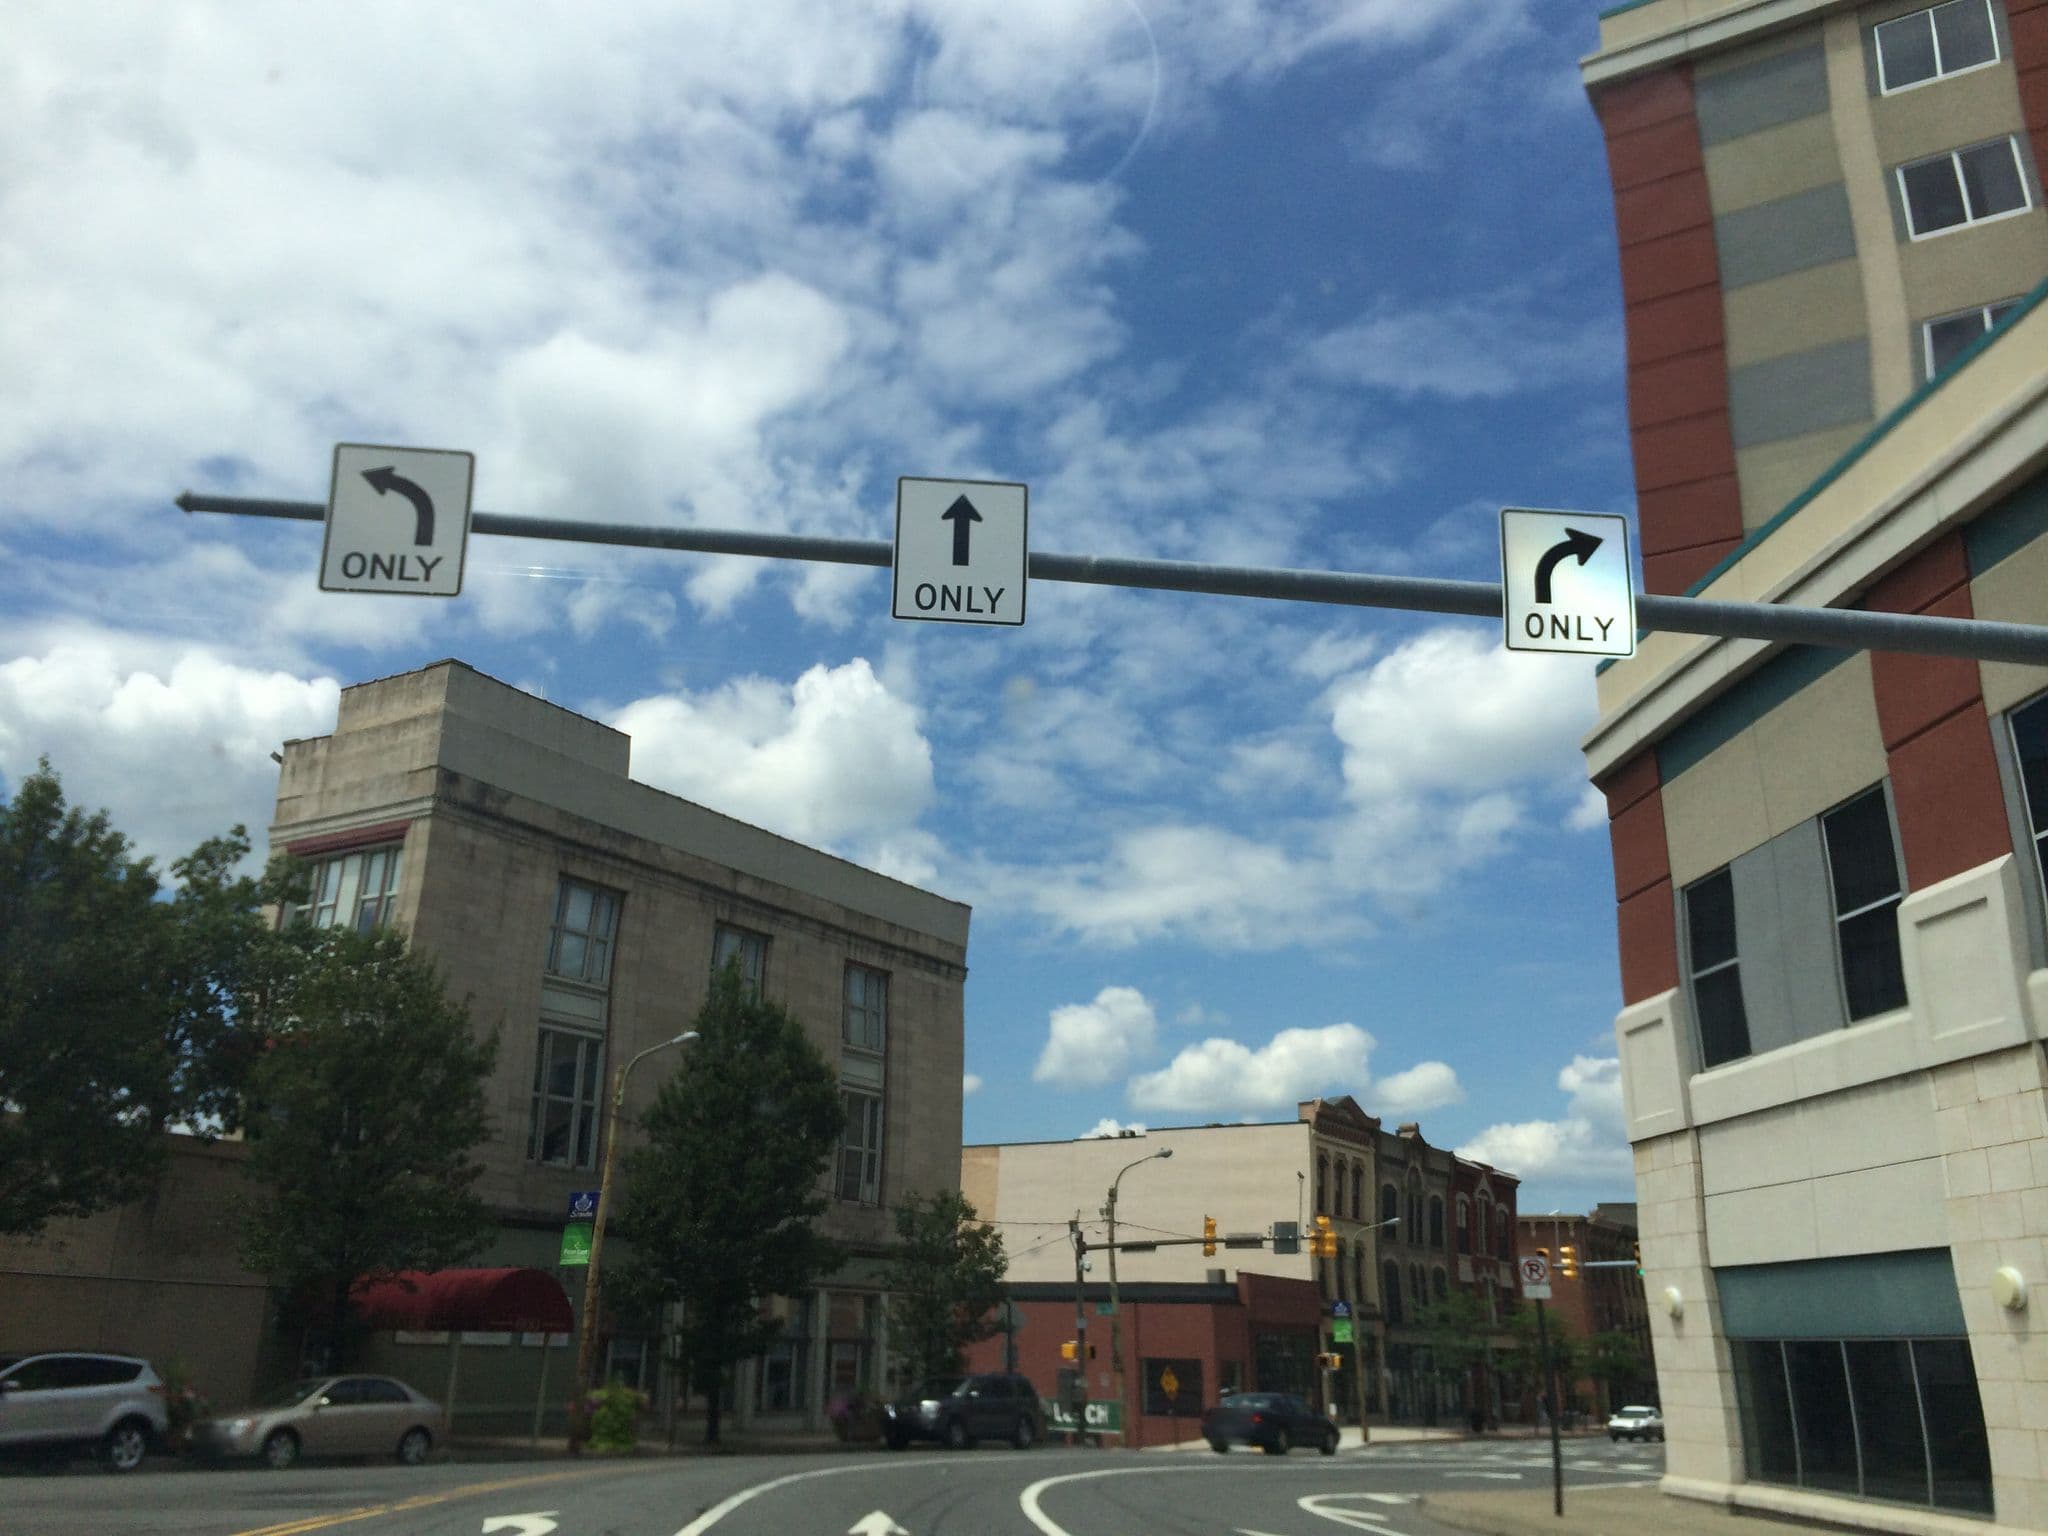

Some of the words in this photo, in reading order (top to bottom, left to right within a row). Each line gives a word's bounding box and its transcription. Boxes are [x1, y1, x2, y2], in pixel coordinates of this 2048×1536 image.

[342, 551, 443, 582] ONLY
[915, 583, 1005, 614] ONLY
[1525, 612, 1615, 642] ONLY
